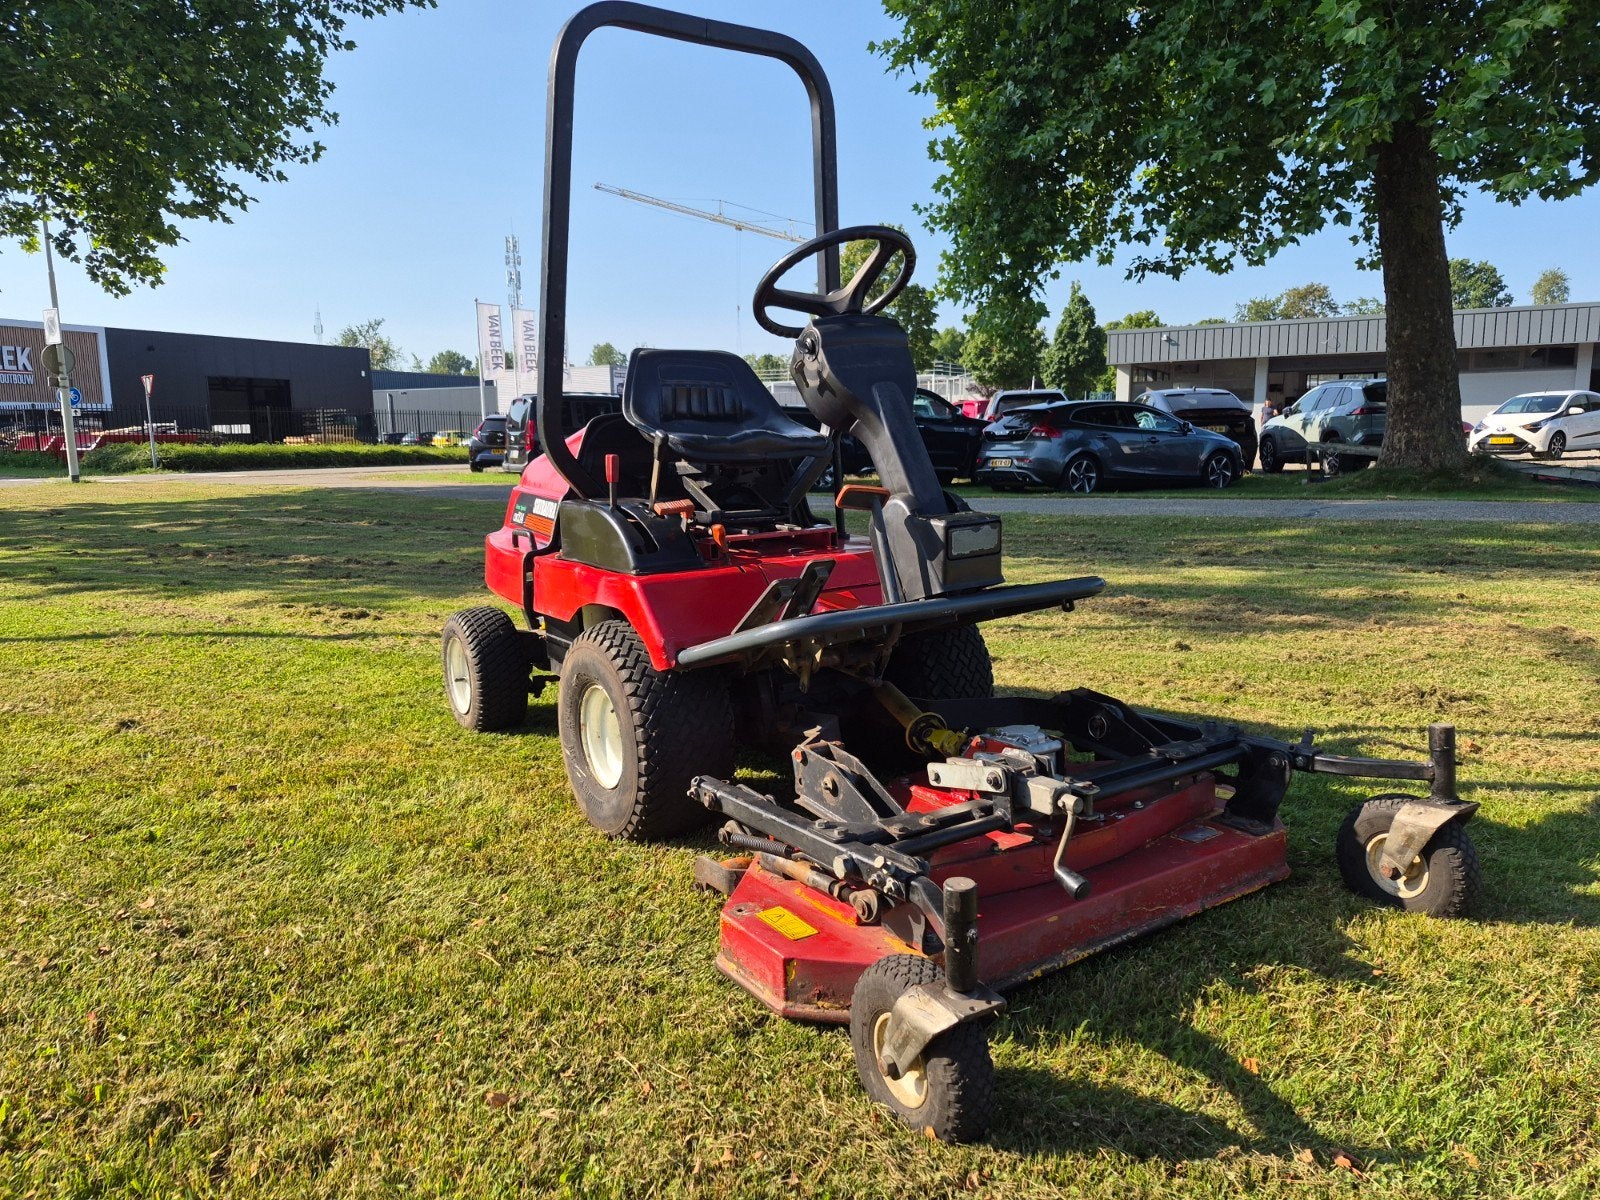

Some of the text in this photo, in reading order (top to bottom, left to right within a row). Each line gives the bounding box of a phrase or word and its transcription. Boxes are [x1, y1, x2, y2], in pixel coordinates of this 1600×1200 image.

[488, 315, 501, 338] VAN
[523, 320, 536, 342] VAN
[0, 345, 33, 371] EK
[490, 341, 504, 370] BEEK
[525, 345, 538, 373] BEEK
